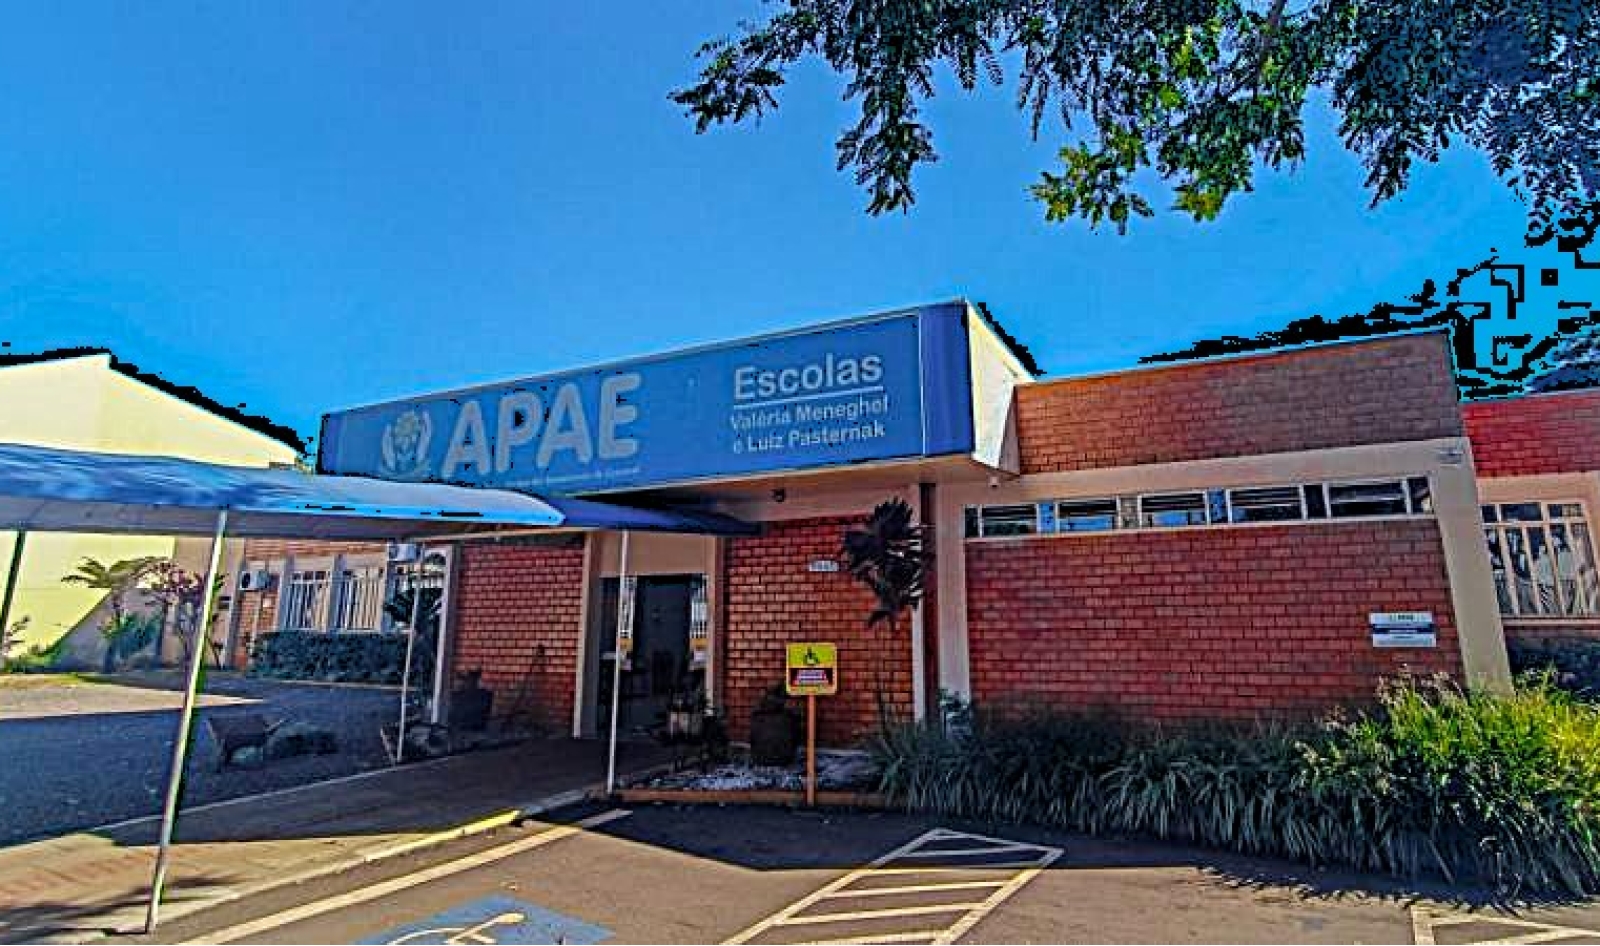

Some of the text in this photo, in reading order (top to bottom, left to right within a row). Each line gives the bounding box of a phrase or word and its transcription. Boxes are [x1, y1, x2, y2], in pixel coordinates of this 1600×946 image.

[734, 353, 882, 401] Escolas
[441, 374, 641, 478] APAE
[748, 434, 785, 451] Luiz
[788, 420, 886, 447] Pasternak
